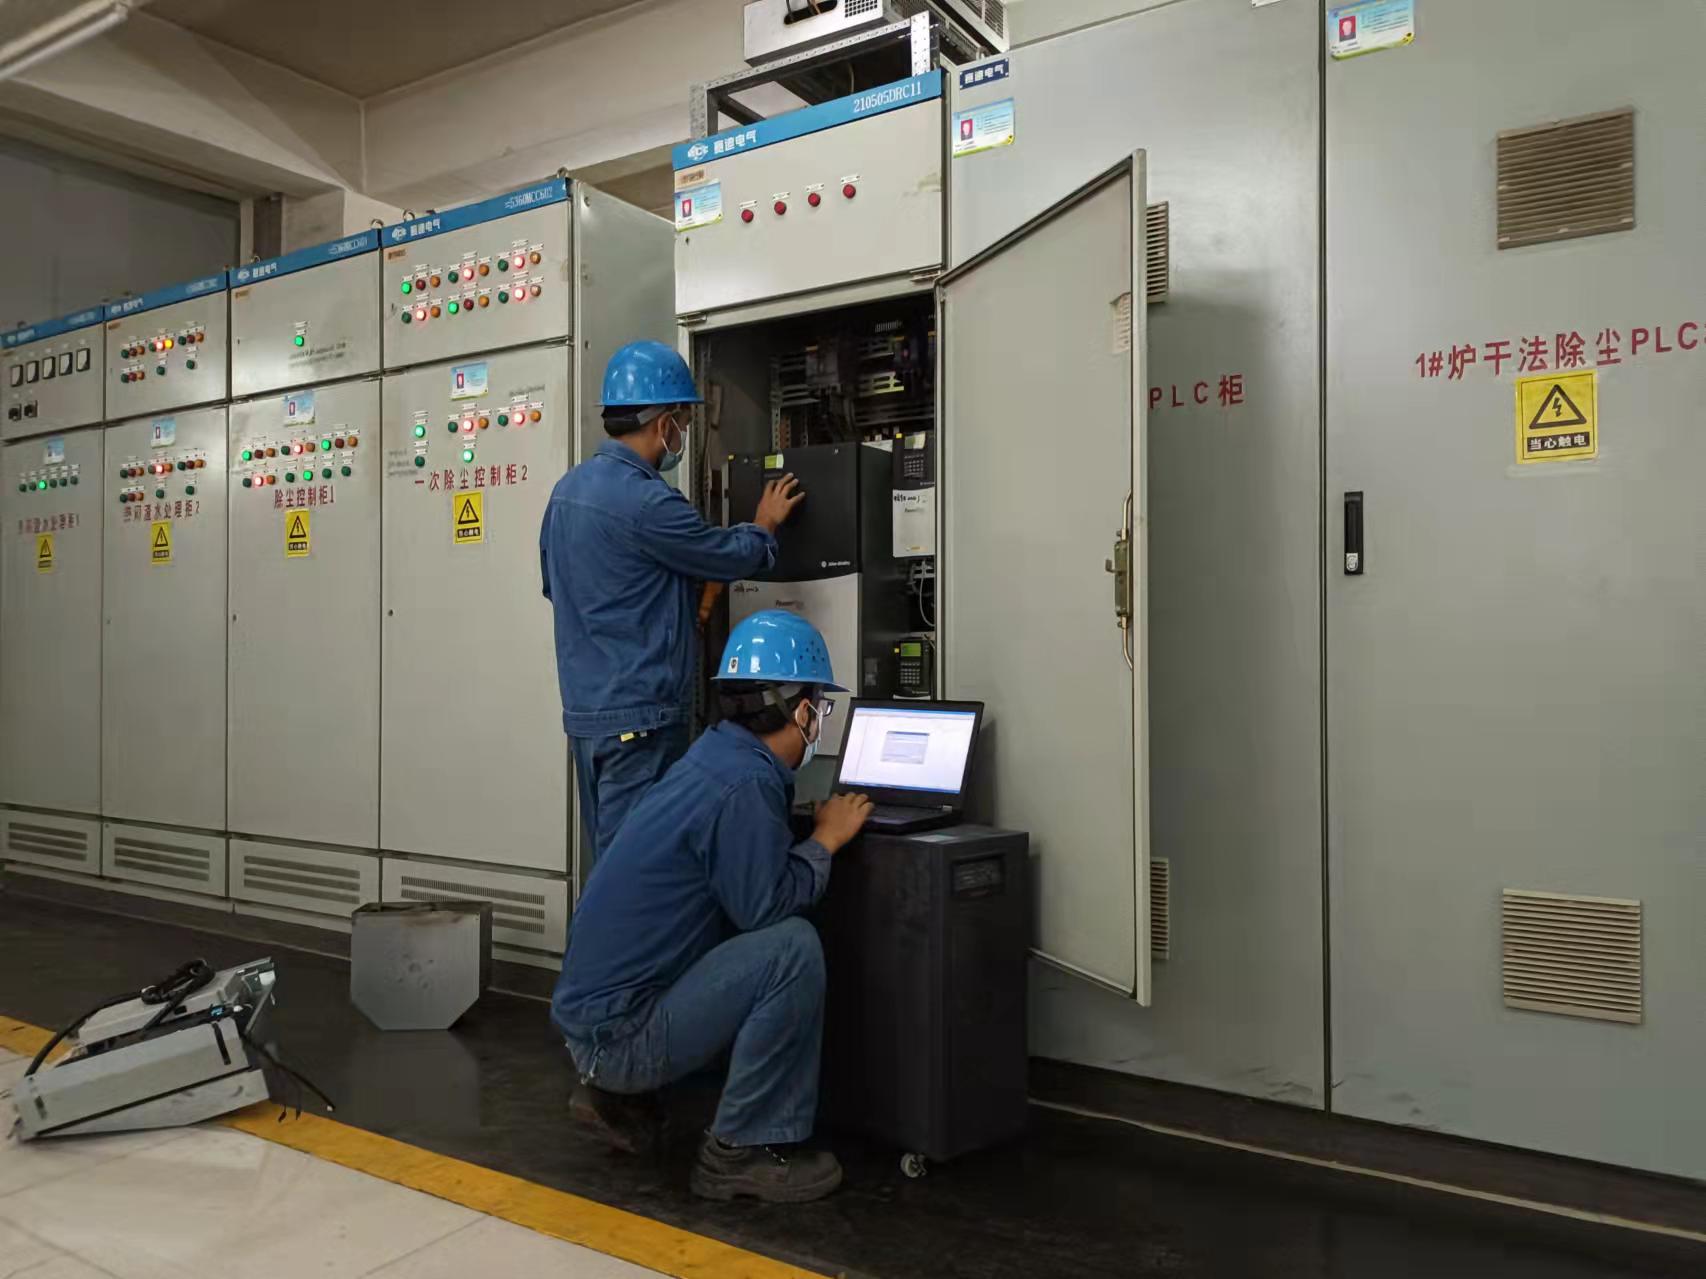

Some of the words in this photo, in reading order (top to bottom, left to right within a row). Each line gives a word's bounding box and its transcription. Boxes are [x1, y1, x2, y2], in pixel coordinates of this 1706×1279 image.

[854, 82, 921, 112] 210505DRC11
[1415, 322, 1706, 380] 1#炉干法除尘PLC
[1149, 373, 1244, 409] PLC柜
[1529, 434, 1587, 451] 当心触电
[414, 464, 528, 491] 一次除尘控制柜2
